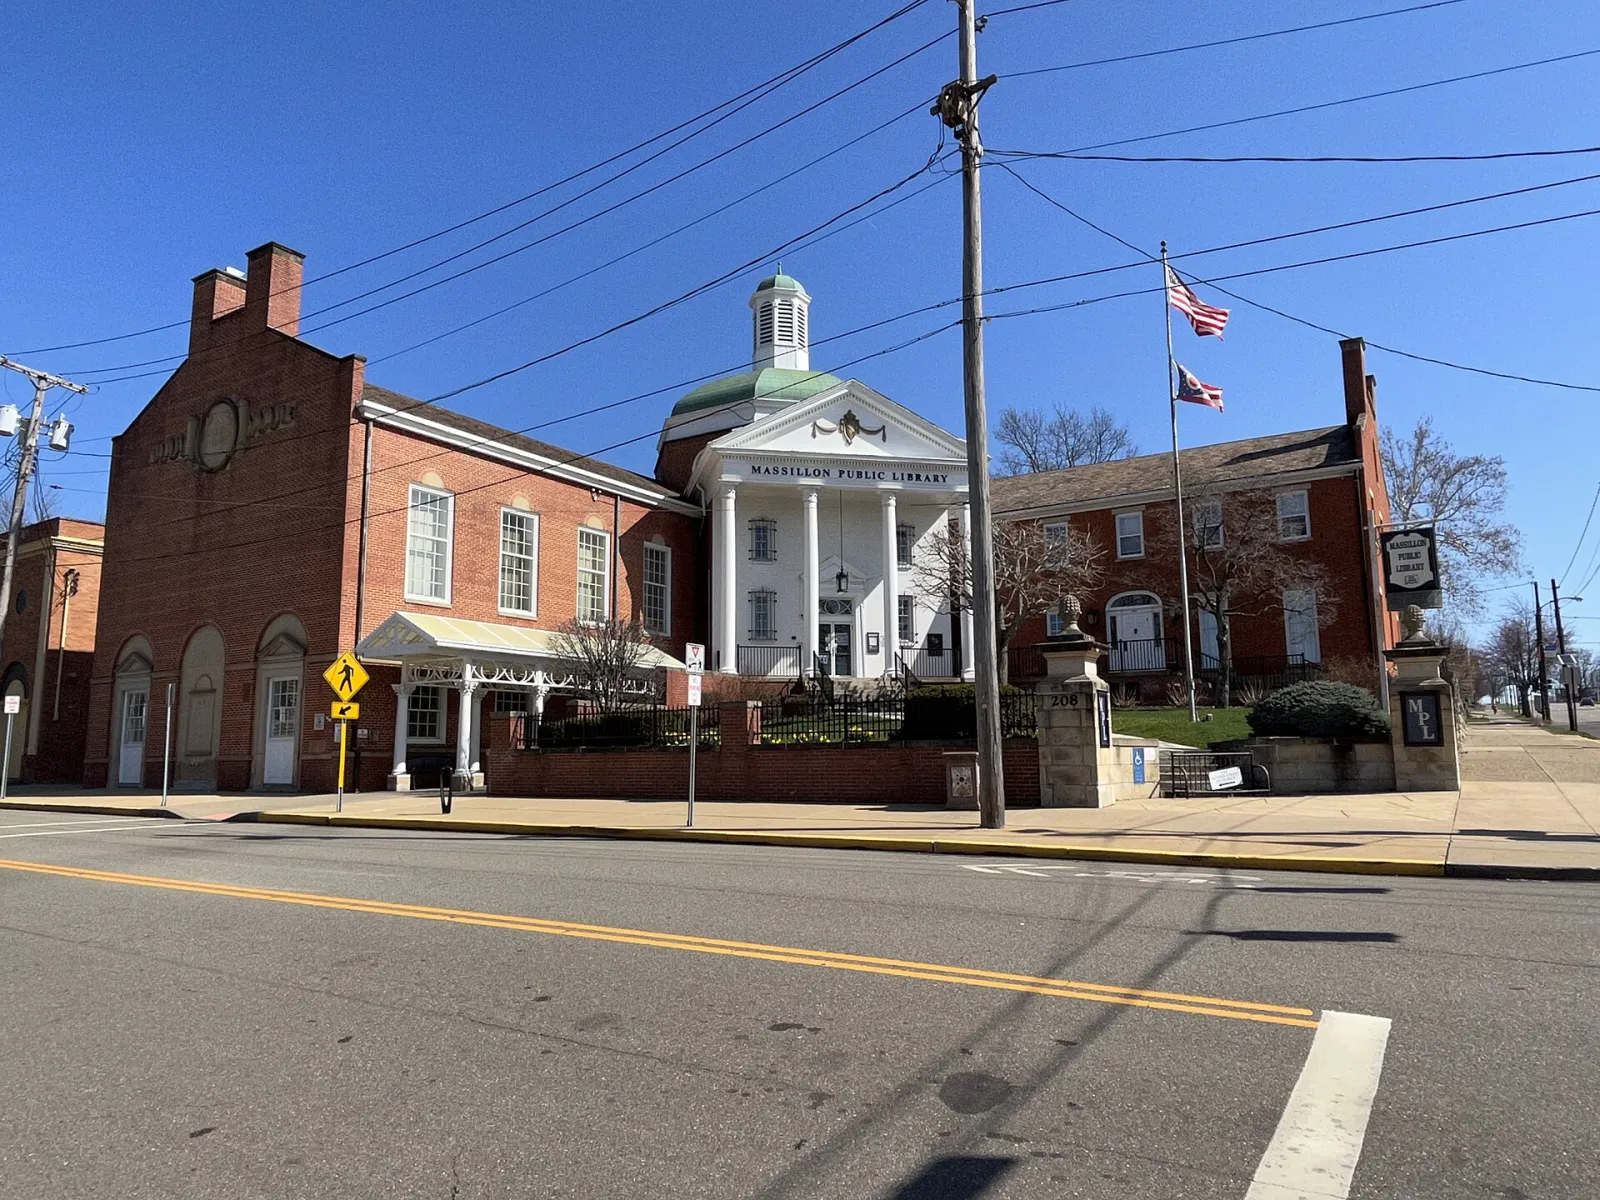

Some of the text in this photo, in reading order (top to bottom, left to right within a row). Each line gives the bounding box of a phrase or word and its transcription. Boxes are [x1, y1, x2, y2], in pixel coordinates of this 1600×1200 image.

[751, 465, 948, 483] MASSILLON PUBLIC LIBRARY
[1389, 539, 1427, 550] MASSILLON
[1398, 551, 1421, 561] PUBLIC
[1395, 562, 1425, 573] LIBRARY
[1051, 694, 1079, 707] 208
